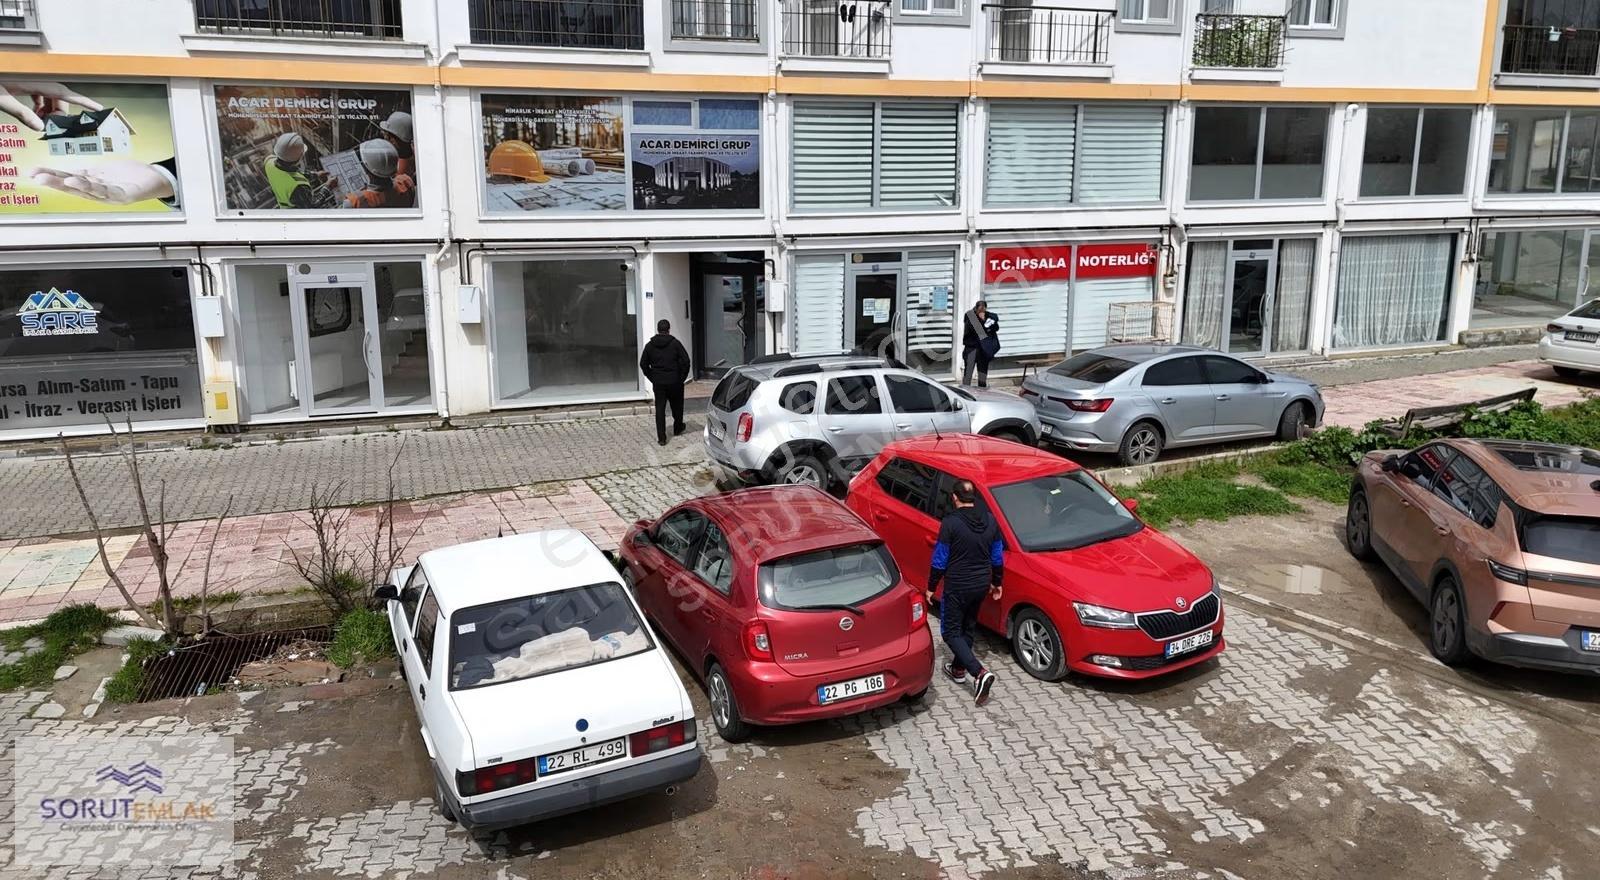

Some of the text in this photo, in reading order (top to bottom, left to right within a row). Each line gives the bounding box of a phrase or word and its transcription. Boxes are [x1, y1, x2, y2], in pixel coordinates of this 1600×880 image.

[228, 95, 377, 110] ACAR DEMİRCİ GRUP
[640, 138, 751, 150] ACAR DEMİRCİ GRUP
[13, 192, 39, 206] İşleri
[21, 312, 97, 330] SARE
[141, 376, 178, 390] Tapu
[25, 401, 62, 418] İfraz
[142, 395, 181, 412] İşleri
[784, 652, 809, 660] MICRA
[825, 677, 882, 699] 22 PG 186
[548, 755, 565, 769] 22
[573, 750, 589, 764] RL
[598, 741, 622, 756] 499
